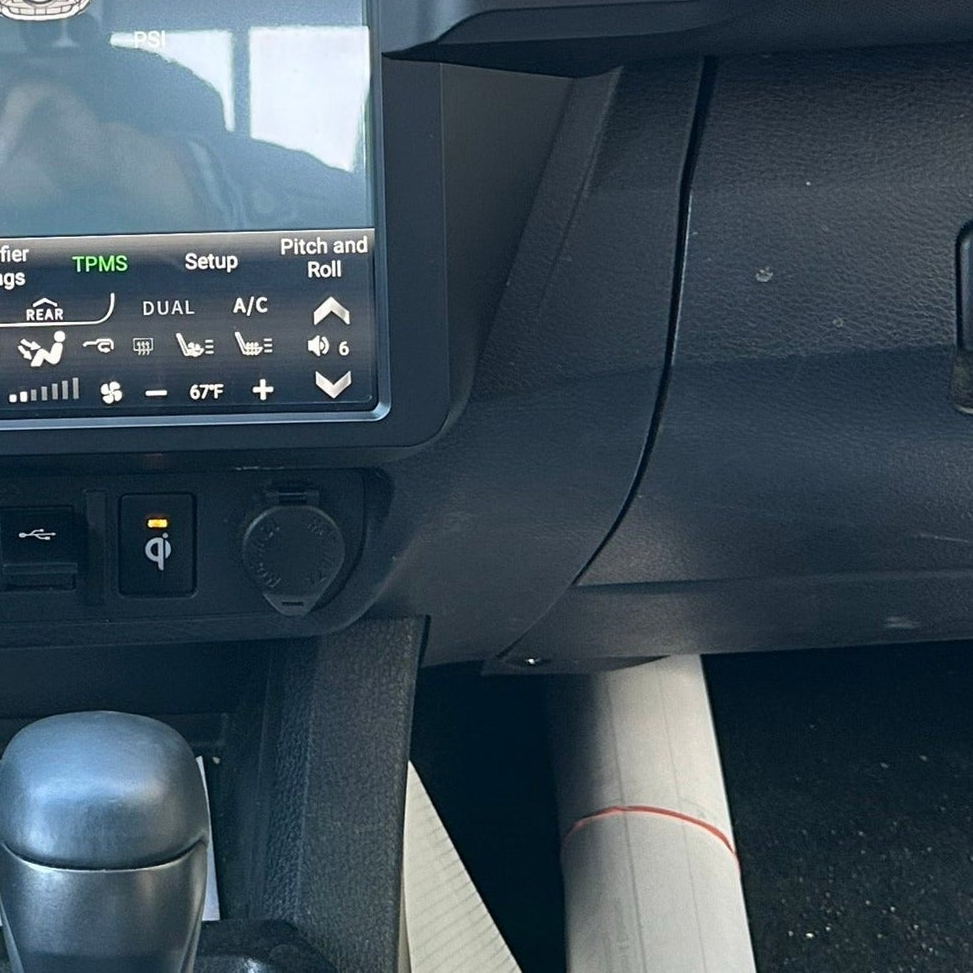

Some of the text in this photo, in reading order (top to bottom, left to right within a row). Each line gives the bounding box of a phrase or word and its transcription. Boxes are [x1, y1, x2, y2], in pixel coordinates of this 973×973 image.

[133, 30, 167, 48] PSI
[280, 235, 368, 256] Pitch and
[72, 255, 129, 273] TPMS
[184, 253, 238, 273] Setup
[307, 259, 342, 278] Roll
[25, 308, 64, 322] REAR
[142, 299, 195, 316] DUAL
[232, 296, 269, 317] A/C
[338, 342, 350, 356] 6
